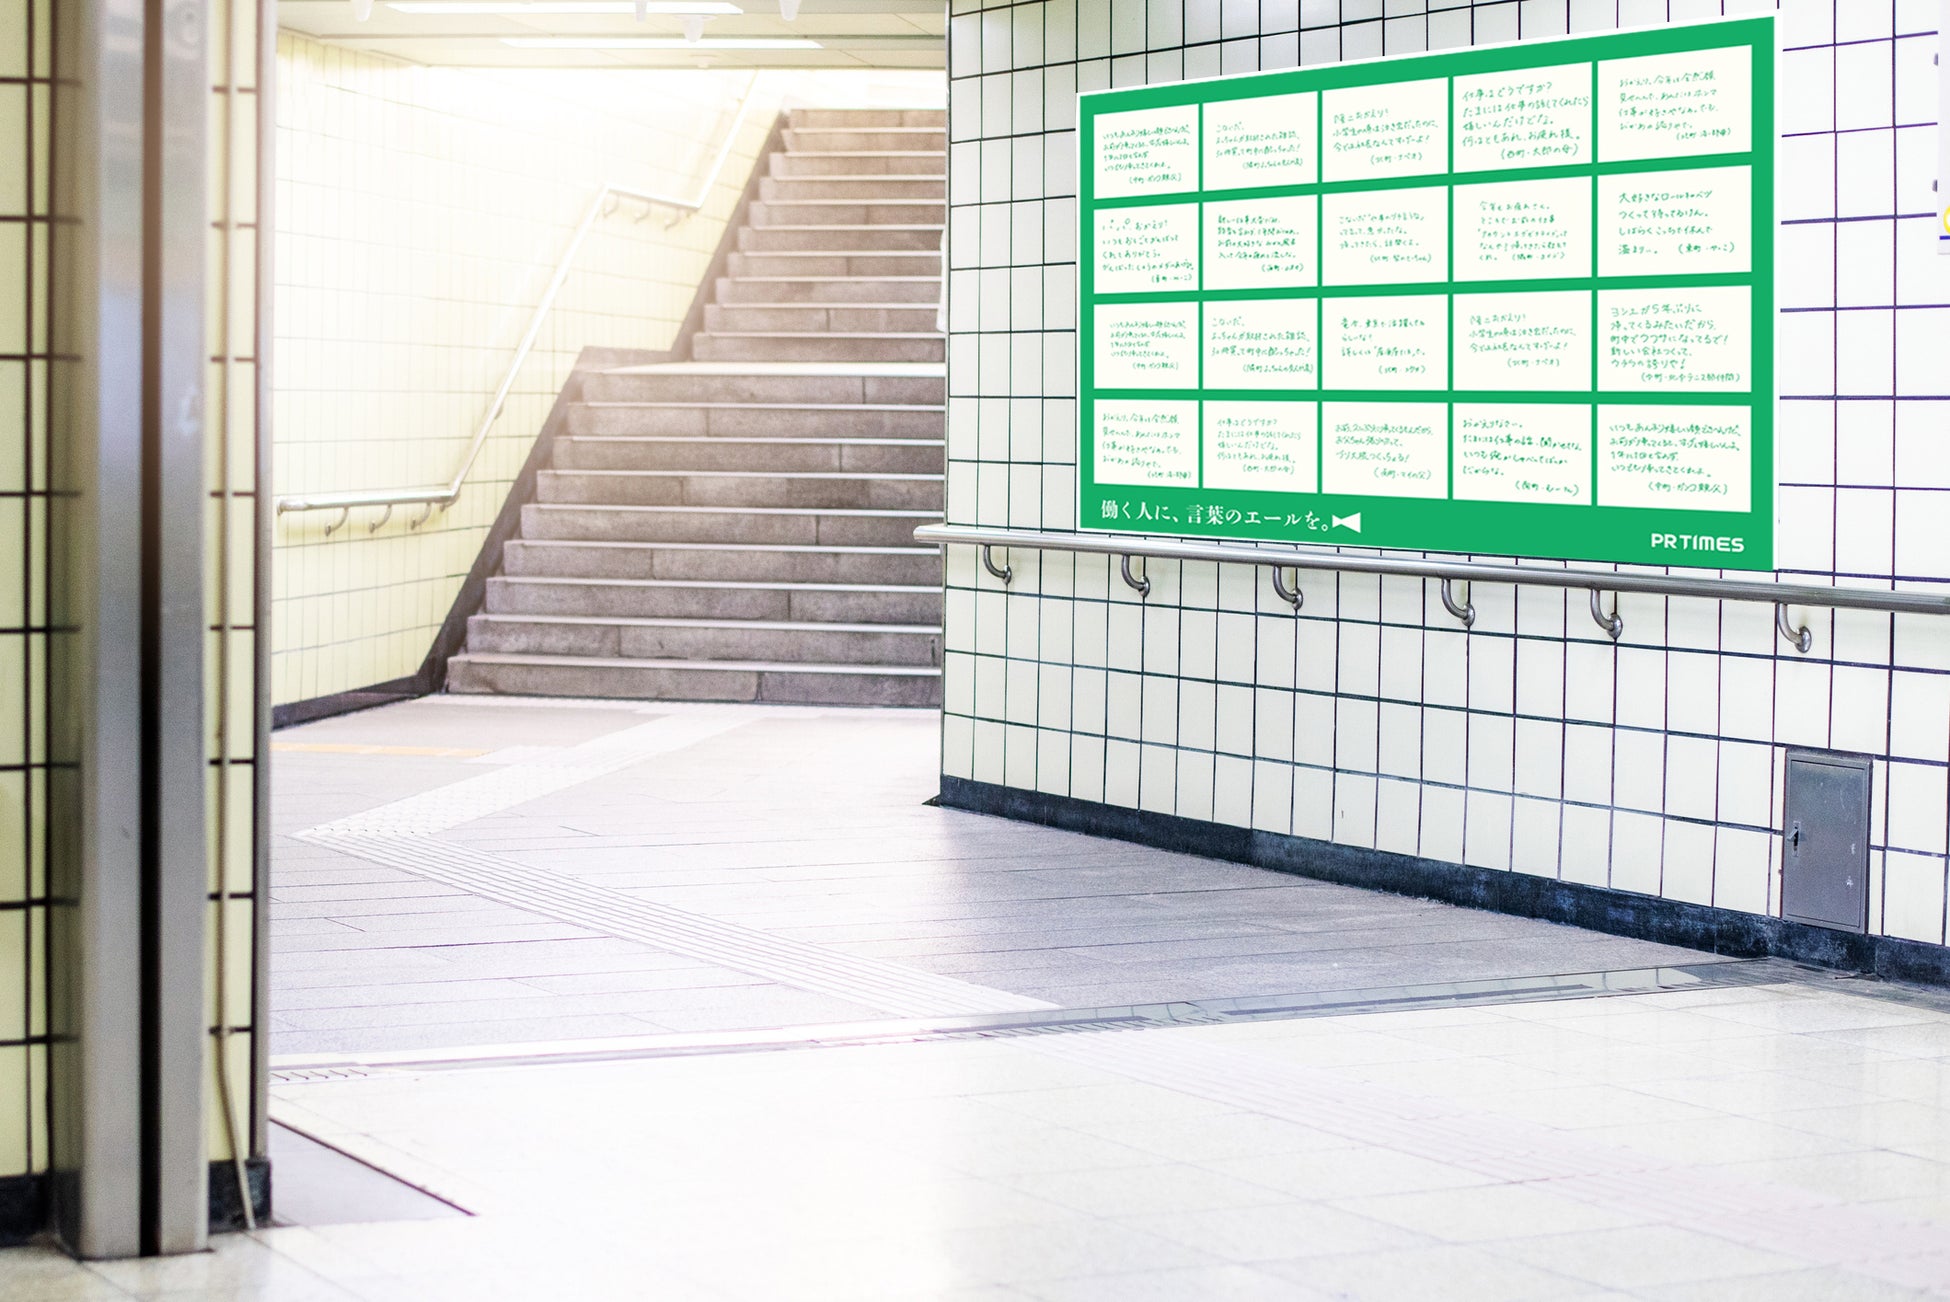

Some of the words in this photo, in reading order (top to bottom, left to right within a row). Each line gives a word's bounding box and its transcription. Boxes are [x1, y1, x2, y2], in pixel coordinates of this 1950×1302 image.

[1101, 499, 1329, 532] 働く人に、言葉のエールを。
